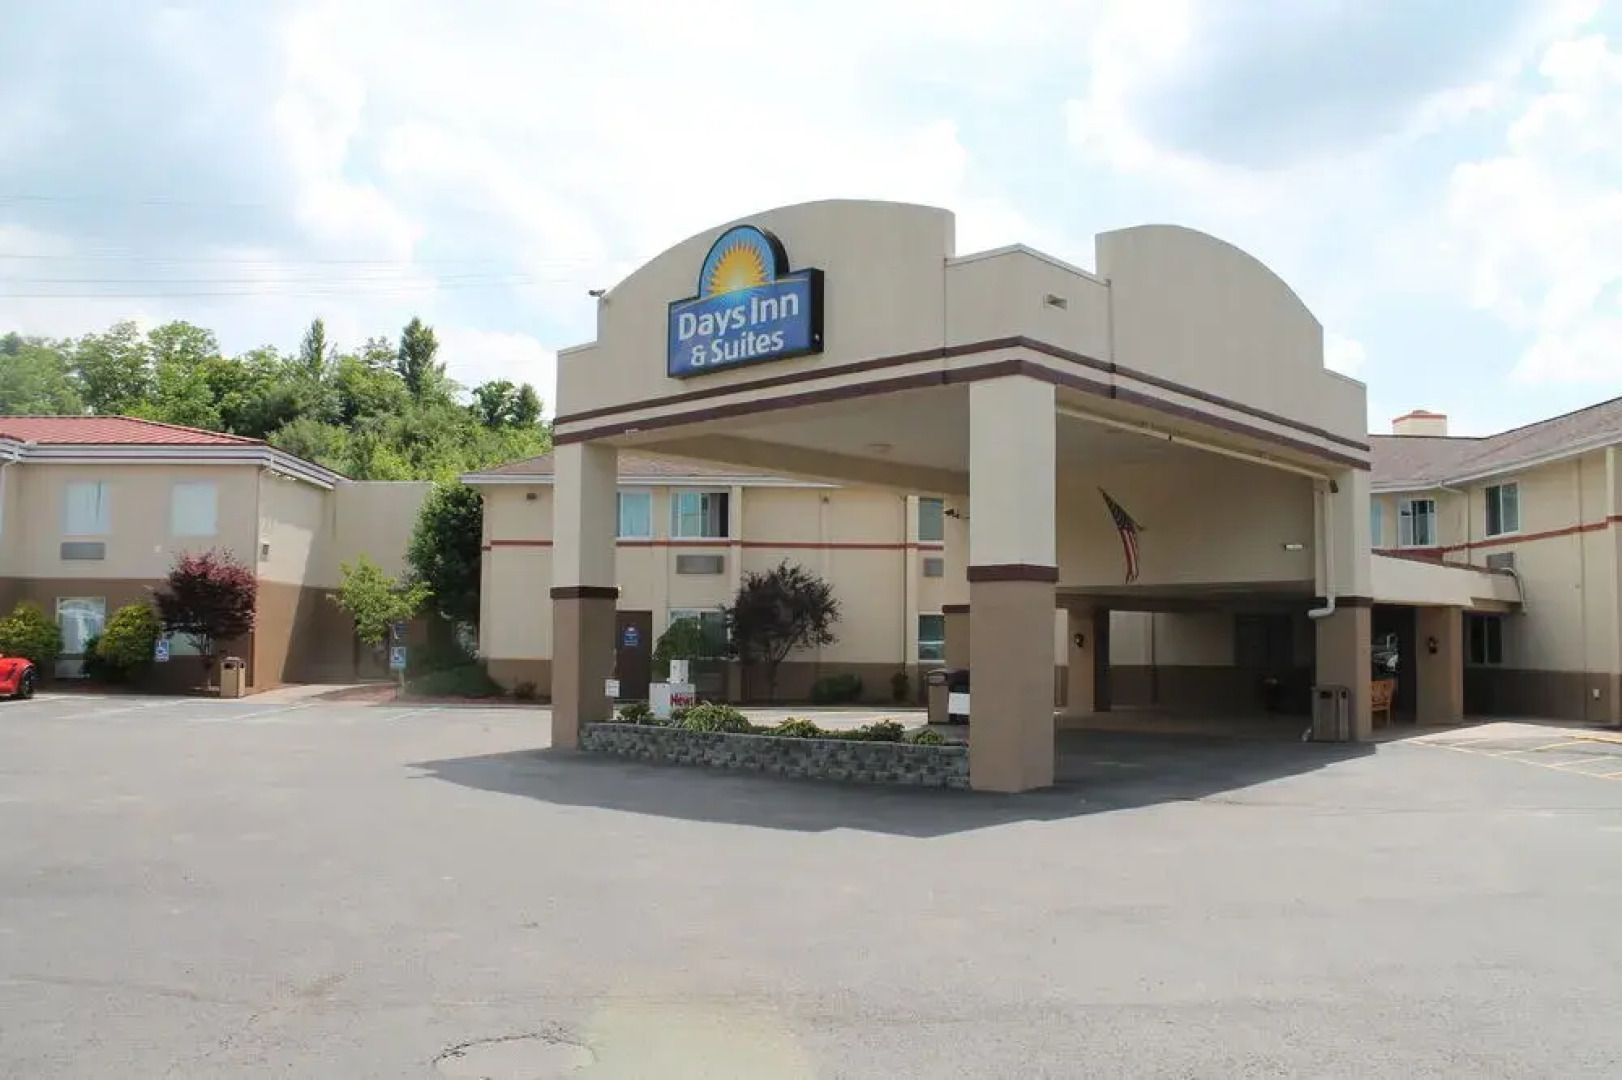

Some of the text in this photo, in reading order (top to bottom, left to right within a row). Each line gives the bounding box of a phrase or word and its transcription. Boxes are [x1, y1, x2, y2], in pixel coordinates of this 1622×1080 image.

[679, 292, 799, 341] Days Inn
[690, 330, 784, 366] & Suites
